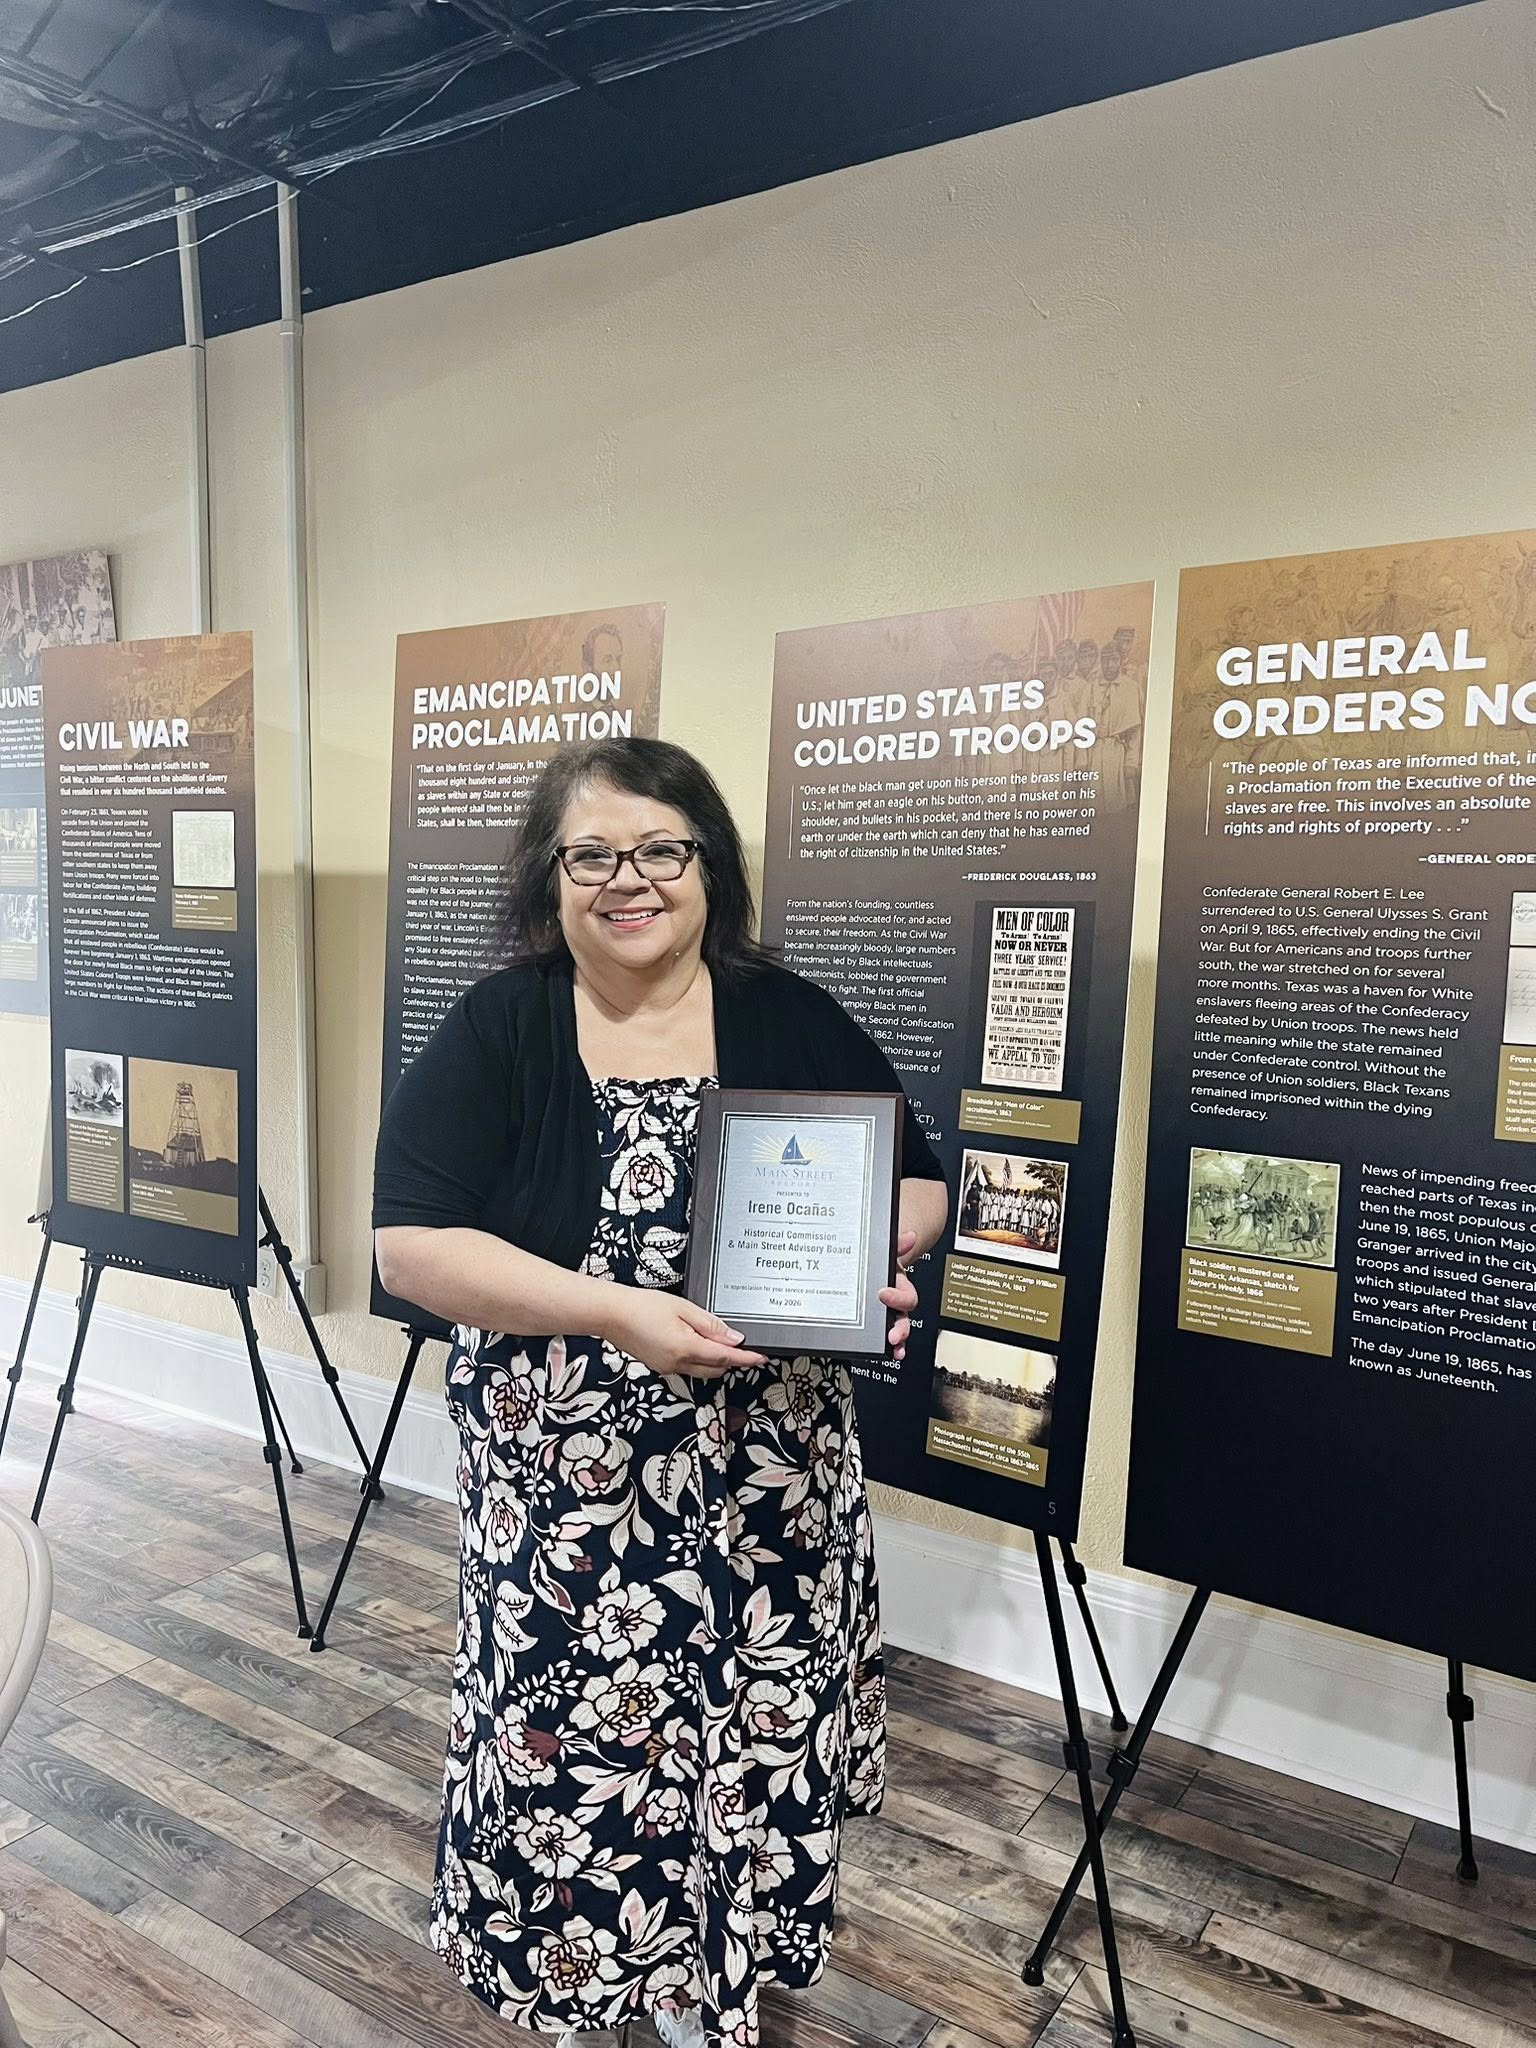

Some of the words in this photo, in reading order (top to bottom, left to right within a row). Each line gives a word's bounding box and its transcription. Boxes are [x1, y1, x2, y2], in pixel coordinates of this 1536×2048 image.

[1216, 629, 1486, 686] GENERAL
[414, 670, 621, 714] EMANCIPATION
[797, 694, 907, 730] UNITED
[916, 679, 1044, 719] STATES
[1213, 688, 1445, 739] ORDERS
[59, 722, 123, 751] CIVIL
[128, 718, 189, 749] WAR
[413, 709, 632, 749] PROCLAMATION
[794, 731, 940, 767] COLORED
[949, 718, 1096, 756] TROOPS
[435, 765, 445, 773] on
[446, 763, 457, 772] the
[458, 762, 472, 772] first
[473, 762, 486, 773] day
[487, 761, 495, 771] of
[496, 761, 526, 771] January,
[527, 759, 534, 769] in
[1222, 761, 1255, 774] “The
[1259, 759, 1308, 776] people
[1312, 757, 1328, 772] of
[1331, 757, 1373, 771] Texas
[1376, 758, 1402, 769] are
[1406, 752, 1478, 768] informed
[1483, 751, 1521, 767] that,
[60, 787, 71, 796] that
[72, 787, 93, 796] resulted
[94, 787, 100, 795] in
[100, 788, 113, 796] over
[113, 787, 121, 796] six
[122, 786, 146, 795] hundred
[146, 786, 173, 795] thousand
[173, 786, 204, 795] battlefield
[205, 786, 227, 795] deaths.
[800, 785, 826, 796] “Once
[828, 783, 840, 794] let
[842, 782, 857, 793] the
[859, 781, 883, 793] black
[885, 781, 906, 791] man
[908, 779, 924, 792] get
[927, 779, 952, 791] upon
[954, 776, 969, 787] his
[971, 776, 1007, 788] person
[1010, 773, 1028, 785] the
[1030, 772, 1060, 784] brass
[1063, 770, 1099, 782] letters
[1225, 801, 1267, 815] slaves
[1270, 803, 1294, 814] are
[1297, 799, 1330, 813] free.
[1335, 798, 1365, 812] This
[1369, 797, 1432, 812] involves
[1436, 799, 1455, 810] an
[1460, 795, 1531, 810] absolute
[1418, 854, 1492, 864] –GENERAL
[962, 872, 1017, 881] –FREDERICK
[1019, 872, 1073, 882] DOUGLASS,
[1076, 872, 1096, 881] 1863
[1203, 886, 1278, 898] Confederate
[1281, 887, 1330, 898] General
[1334, 887, 1380, 899] Robert
[1383, 888, 1396, 899] E.
[1400, 888, 1425, 900] Lee
[786, 899, 807, 908] From
[808, 899, 821, 908] the
[822, 900, 853, 909] nation’s
[854, 899, 892, 911] founding,
[894, 900, 934, 910] countless
[1201, 905, 1275, 917] surrendered
[1278, 906, 1292, 917] to
[1295, 906, 1320, 917] U.S.
[1323, 906, 1374, 918] General
[1377, 907, 1428, 921] Ulysses
[1432, 908, 1444, 920] S.
[1448, 908, 1489, 921] Grant
[997, 910, 1019, 930] MEN
[1021, 911, 1034, 931] OF
[1036, 912, 1069, 932] COLOR
[994, 939, 1018, 951] NOW
[1018, 941, 1032, 951] OR
[1033, 941, 1067, 952] NEVER
[966, 1096, 994, 1106] Broadside
[994, 1099, 1003, 1107] for
[965, 1107, 999, 1116] recruitment,
[999, 1109, 1012, 1117] 1863
[755, 1166, 788, 1178] MAIN
[792, 1167, 834, 1180] STREET
[748, 1200, 782, 1214] Irene
[787, 1202, 835, 1217] Ocañas
[744, 1228, 784, 1239] Historical
[786, 1230, 837, 1241] Commission
[727, 1239, 735, 1249] &
[737, 1240, 759, 1249] Main
[761, 1241, 786, 1251] Street
[788, 1243, 825, 1255] Advisory
[826, 1244, 852, 1255] Board
[756, 1256, 802, 1271] Freeport,
[806, 1259, 820, 1270] TX
[1189, 1257, 1208, 1267] Black
[1209, 1262, 1236, 1272] soldiers
[1237, 1266, 1271, 1277] mustered
[1272, 1272, 1285, 1280] out
[1187, 1278, 1217, 1289] Harper’s
[1218, 1283, 1245, 1295] Weekly,
[1246, 1287, 1264, 1297] 1866
[1188, 1268, 1206, 1277] Little
[1207, 1270, 1227, 1282] Rock,
[1228, 1274, 1263, 1287] Arkansas,
[1263, 1280, 1288, 1291] sketch
[1288, 1284, 1300, 1292] for
[769, 1298, 783, 1306] May
[784, 1299, 802, 1307] 2026
[1351, 1336, 1375, 1351] The
[1378, 1342, 1404, 1358] day
[1407, 1347, 1441, 1363] June
[1445, 1353, 1462, 1368] 19,
[1467, 1357, 1502, 1375] 1865,
[1507, 1364, 1532, 1379] has
[1350, 1355, 1393, 1373] known
[1396, 1366, 1412, 1377] as
[1416, 1368, 1498, 1392] Juneteenth.
[934, 1426, 965, 1441] Photograph
[972, 1438, 999, 1450] members
[1006, 1447, 1016, 1455] the
[1017, 1449, 1031, 1459] 55th
[933, 1436, 971, 1452] Massachusetts
[972, 1446, 994, 1459] Infantry,
[995, 1454, 1009, 1463] circa
[1010, 1457, 1039, 1471] 1863-1865
[1048, 1501, 1056, 1515] 5
